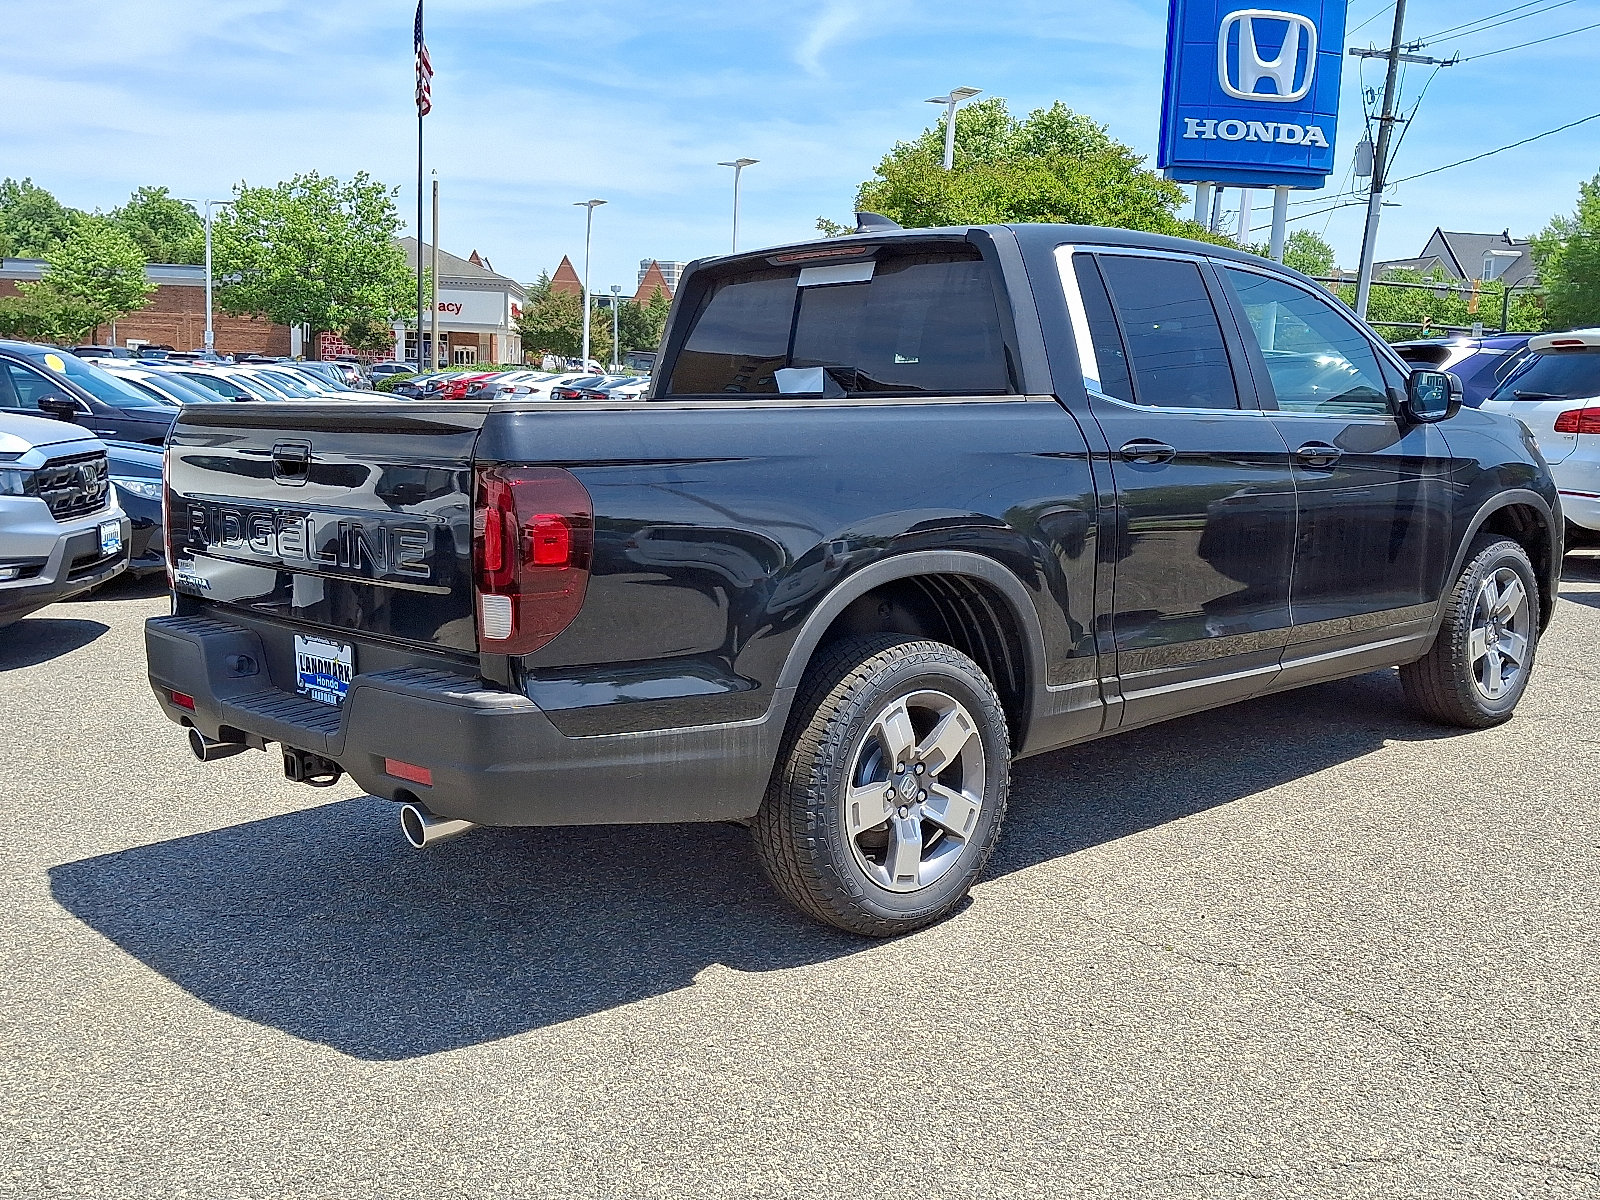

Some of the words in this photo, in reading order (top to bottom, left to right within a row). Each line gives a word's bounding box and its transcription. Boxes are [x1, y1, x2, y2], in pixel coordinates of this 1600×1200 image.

[1183, 118, 1329, 148] HONDA
[187, 503, 430, 578] RIDGELINE
[299, 654, 351, 683] LANDMARK
[316, 675, 339, 689] Honda
